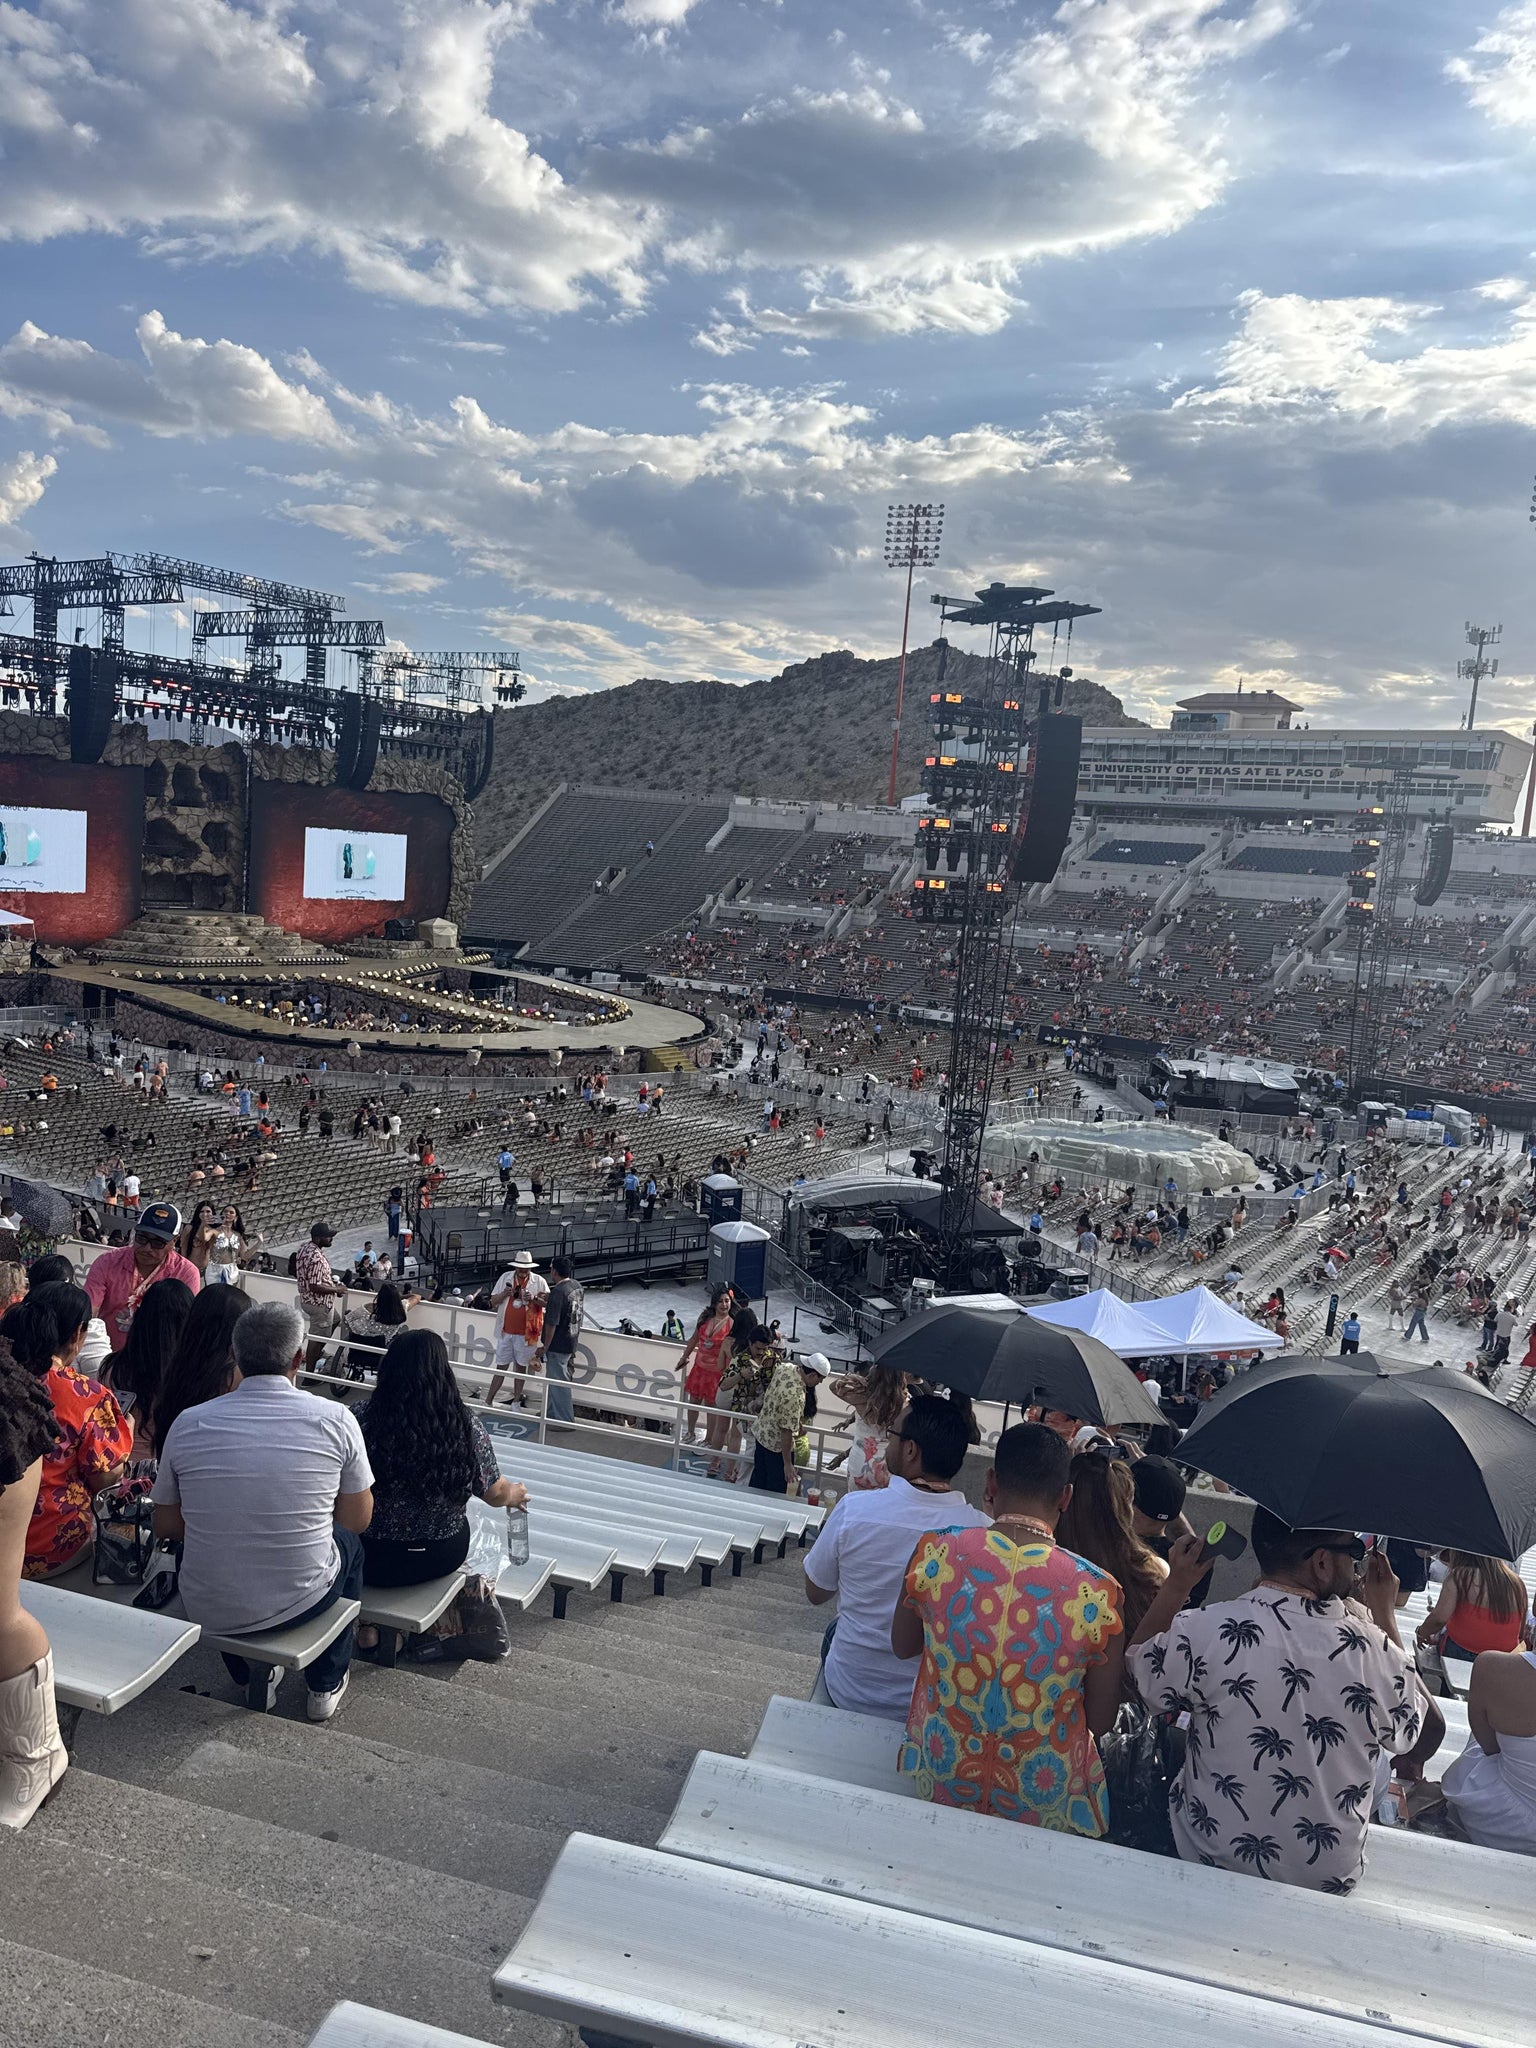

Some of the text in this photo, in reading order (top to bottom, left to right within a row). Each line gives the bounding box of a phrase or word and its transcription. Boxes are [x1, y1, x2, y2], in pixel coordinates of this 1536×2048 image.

[1095, 764, 1172, 775] UNIVERSITY
[1176, 766, 1194, 775] OF
[1198, 766, 1240, 776] TEXAS
[1245, 767, 1262, 777] AT
[1266, 768, 1282, 777] EL
[1286, 768, 1323, 778] PASO
